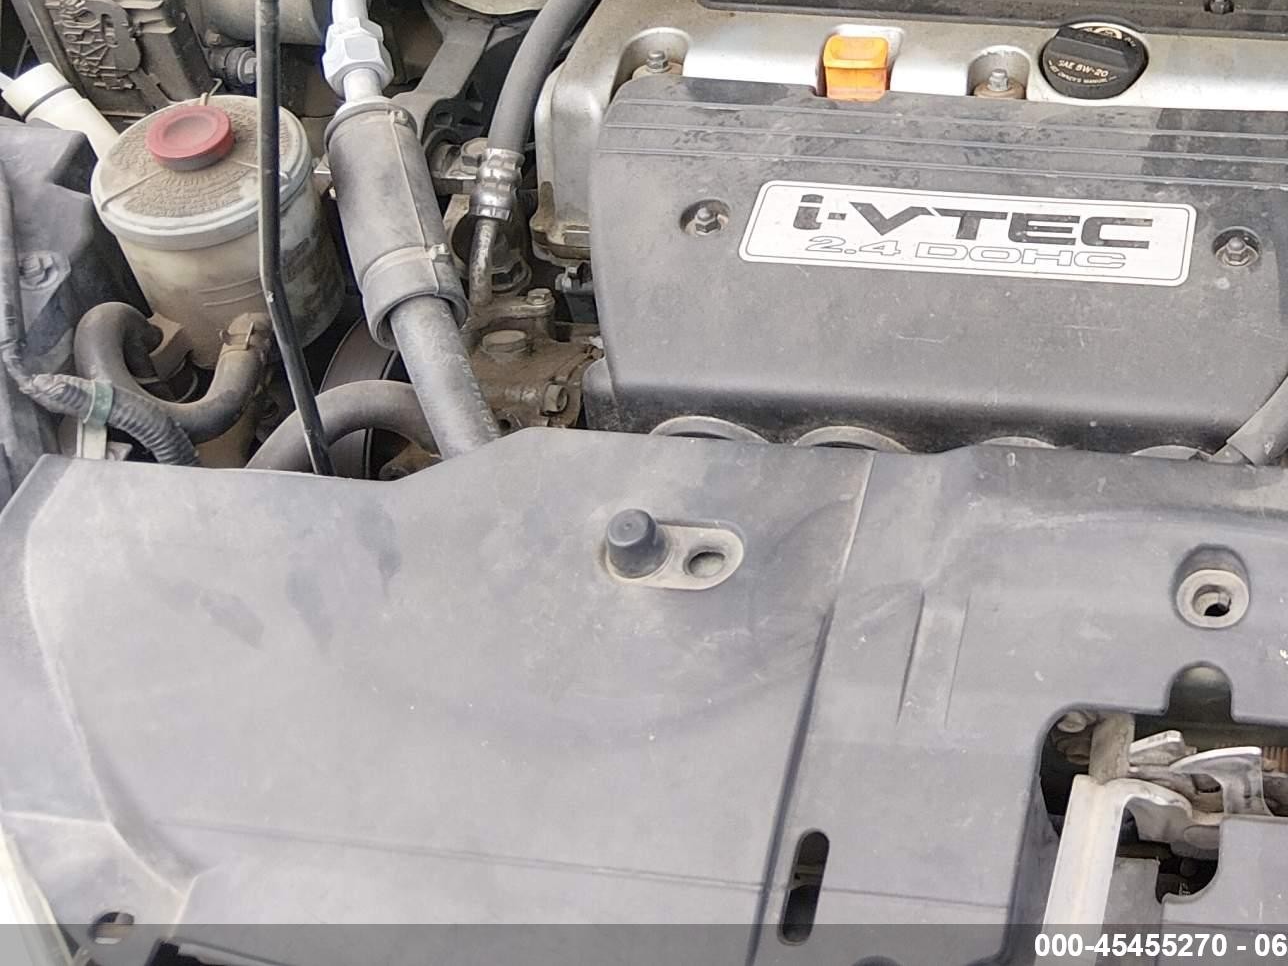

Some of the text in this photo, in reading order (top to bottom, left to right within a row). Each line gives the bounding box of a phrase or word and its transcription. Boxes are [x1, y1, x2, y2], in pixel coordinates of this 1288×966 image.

[793, 193, 1154, 250] i-VTEC
[805, 234, 1127, 270] 2.4 DOHC
